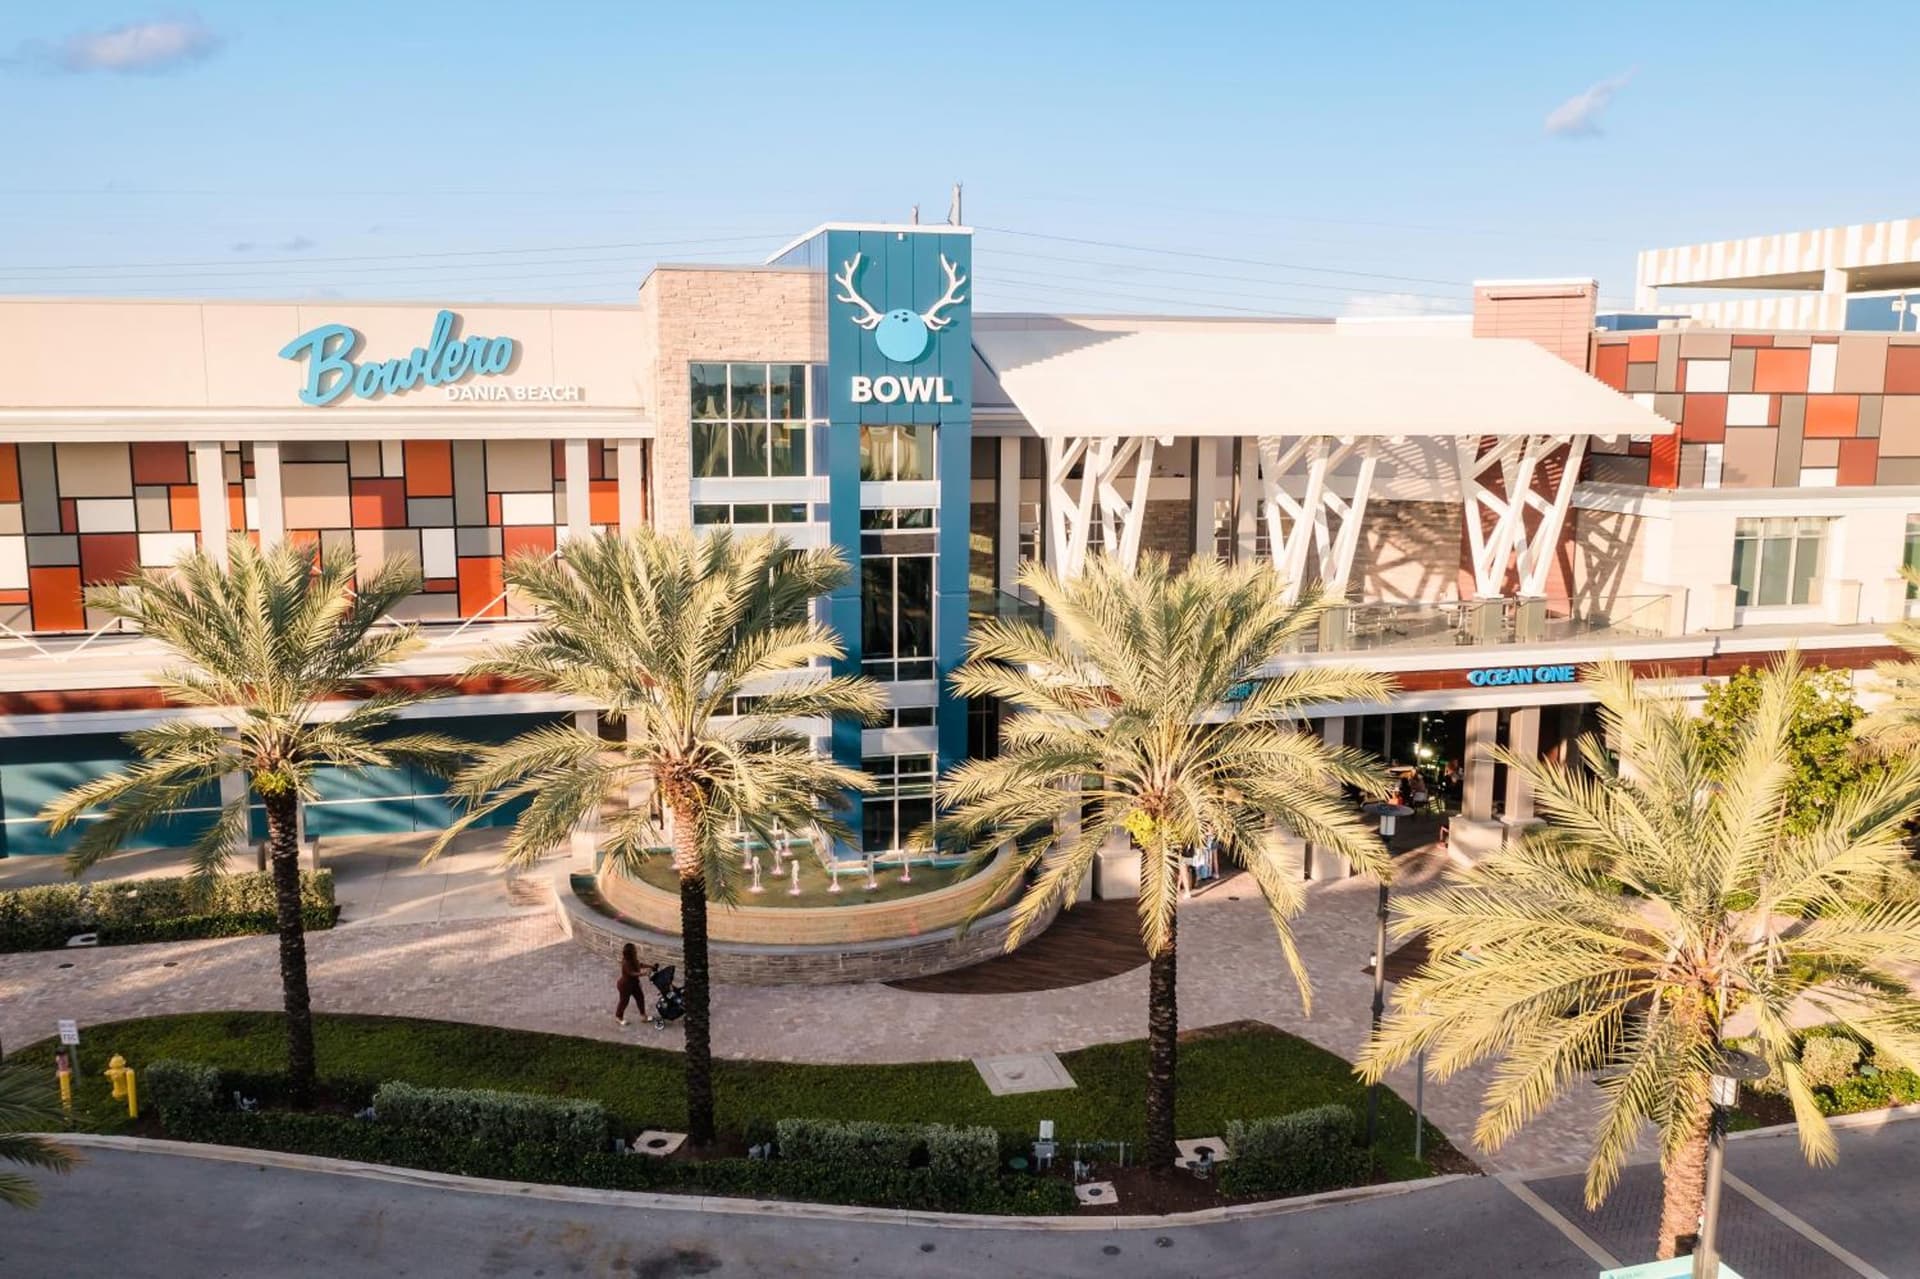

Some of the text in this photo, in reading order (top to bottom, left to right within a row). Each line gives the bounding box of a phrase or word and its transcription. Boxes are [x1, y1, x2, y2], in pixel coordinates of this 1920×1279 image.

[278, 310, 512, 406] Bowlero
[447, 384, 579, 401] DANIA BEACH
[851, 376, 953, 403] BOWL
[1467, 666, 1575, 686] OCEAN ONE
